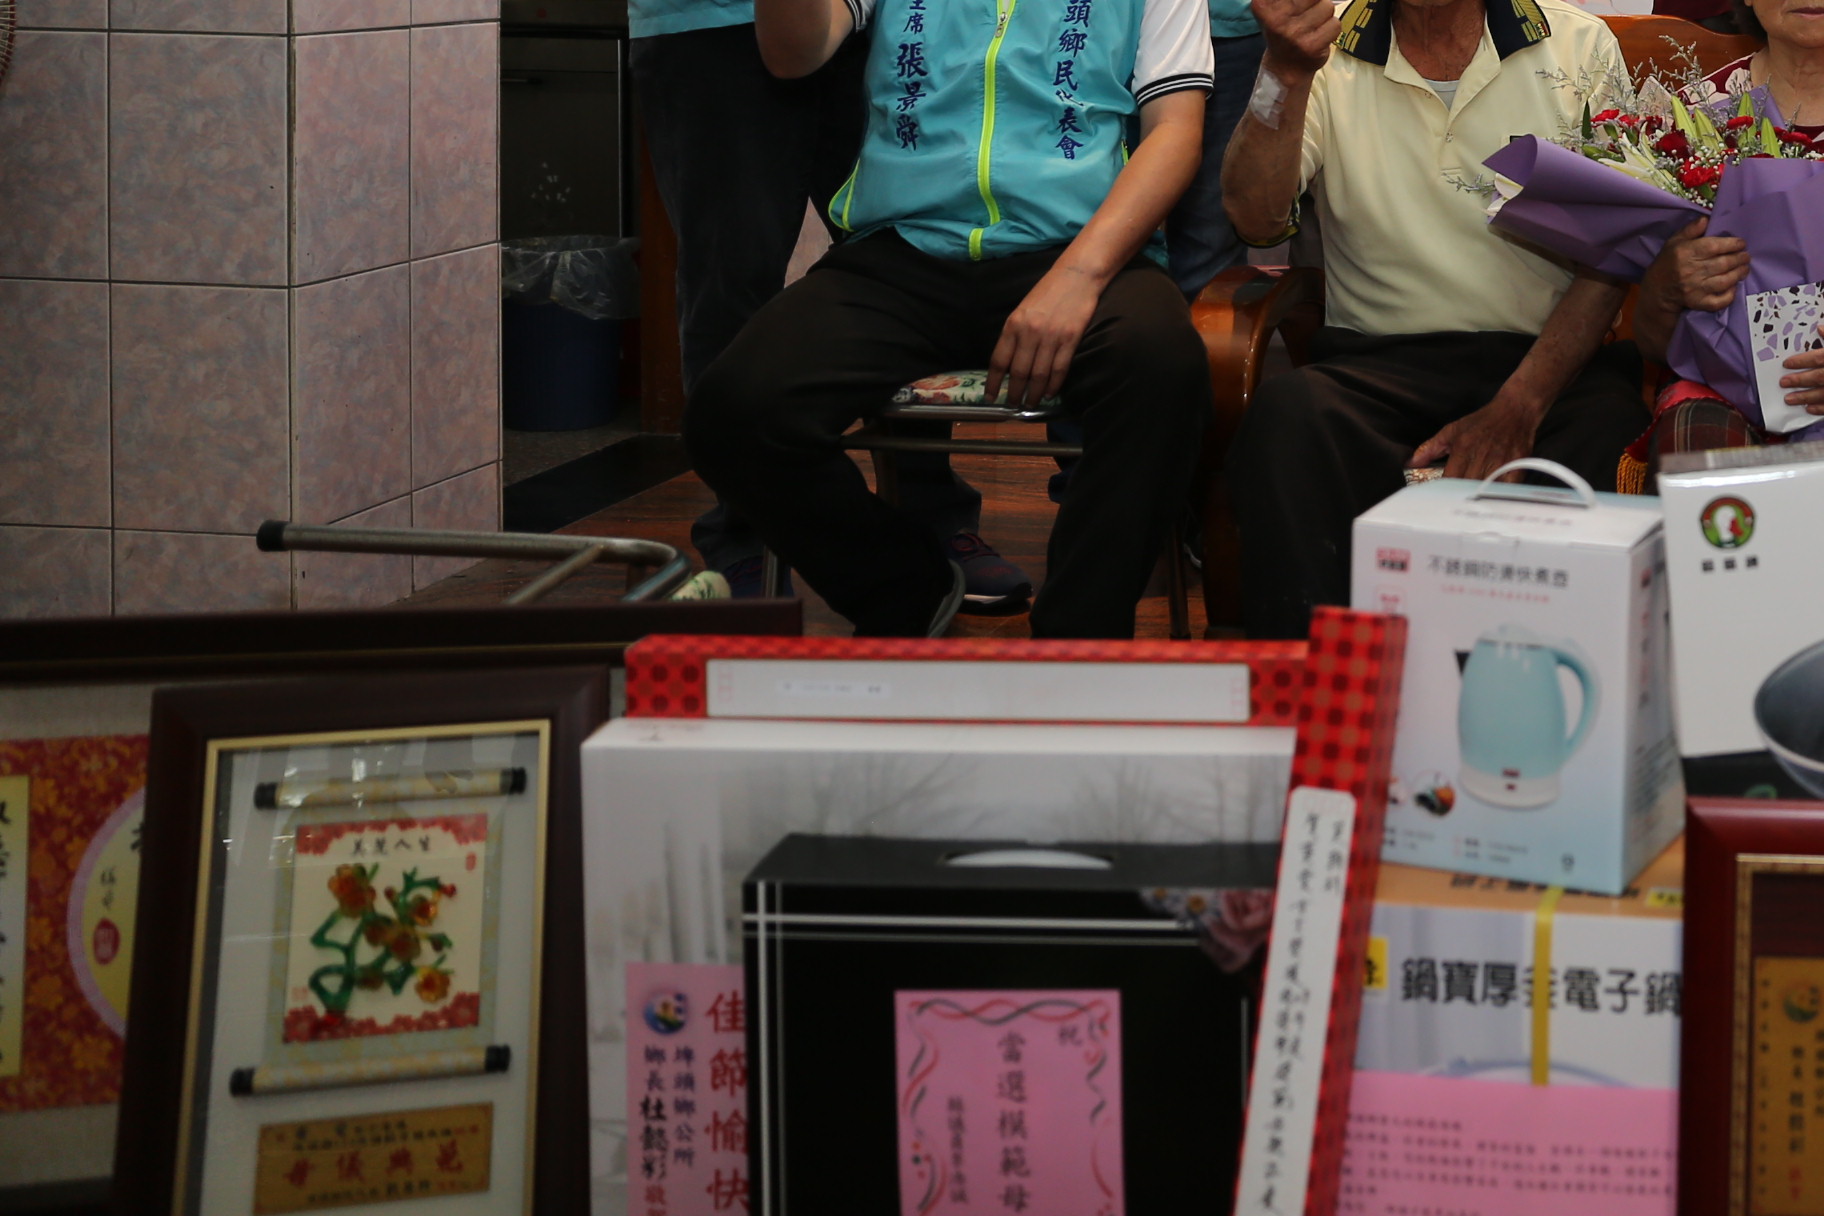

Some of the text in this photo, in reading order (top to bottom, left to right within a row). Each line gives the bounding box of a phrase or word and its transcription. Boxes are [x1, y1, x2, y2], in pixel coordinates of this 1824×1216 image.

[672, 1044, 696, 1168] 埤頭鄉公所
[703, 989, 748, 1211] 佳節愉快
